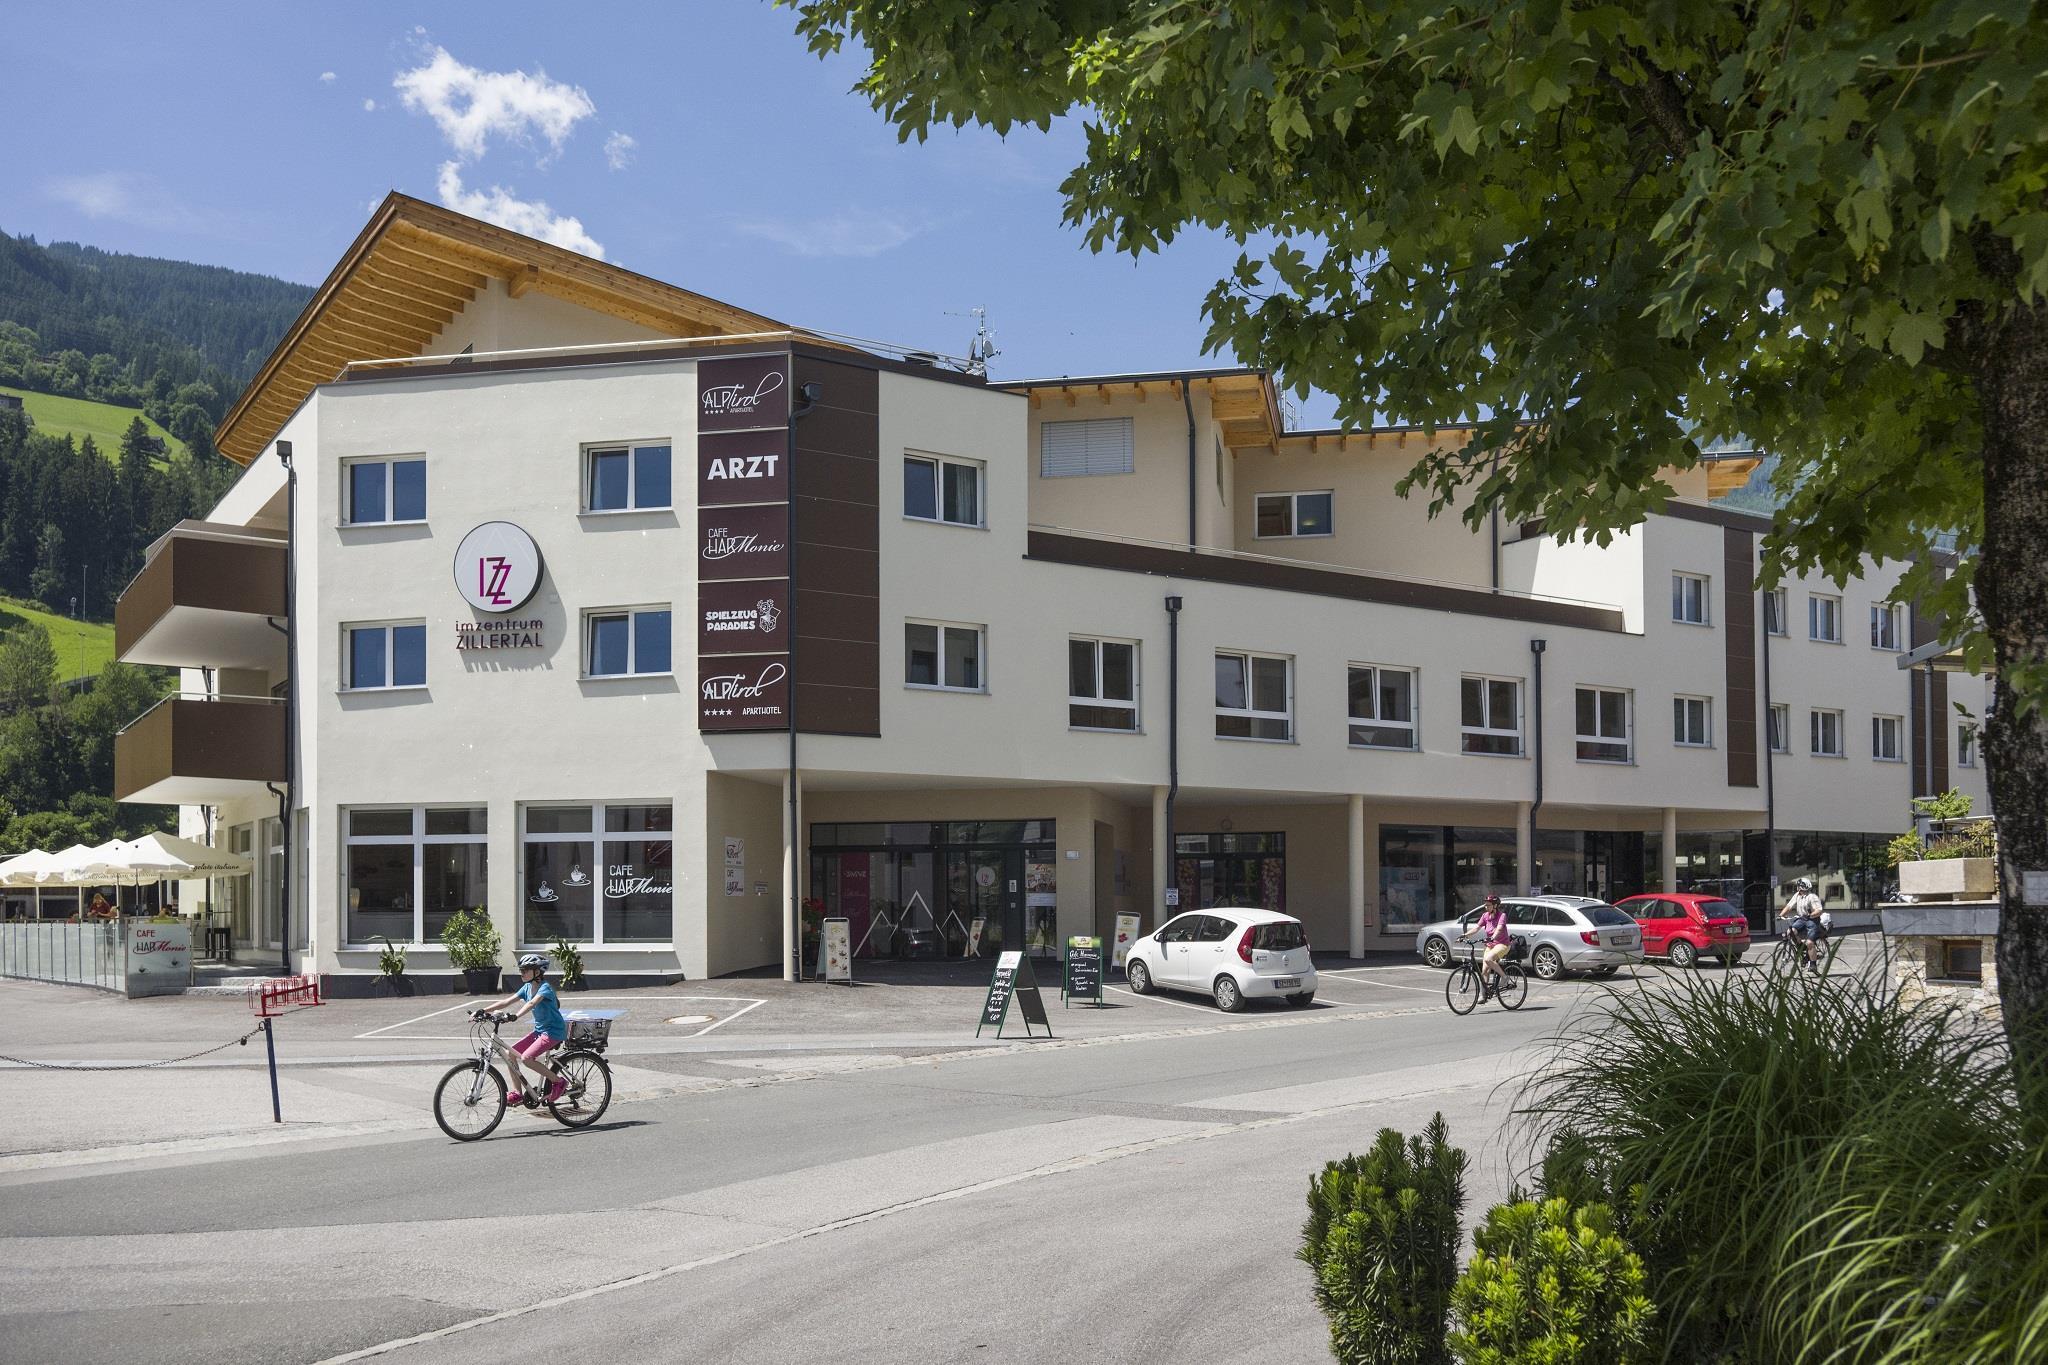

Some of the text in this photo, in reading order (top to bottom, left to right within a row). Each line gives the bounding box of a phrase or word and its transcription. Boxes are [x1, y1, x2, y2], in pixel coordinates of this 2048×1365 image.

[707, 455, 779, 481] ARZT
[708, 527, 728, 538] CAFE
[705, 610, 758, 621] SPIELZEUG
[707, 620, 756, 632] PARADIES
[455, 633, 544, 650] ZILLERTAL
[742, 706, 782, 716] APARTHOTEL
[609, 864, 633, 876] CAFE
[136, 929, 156, 938] CAFE
